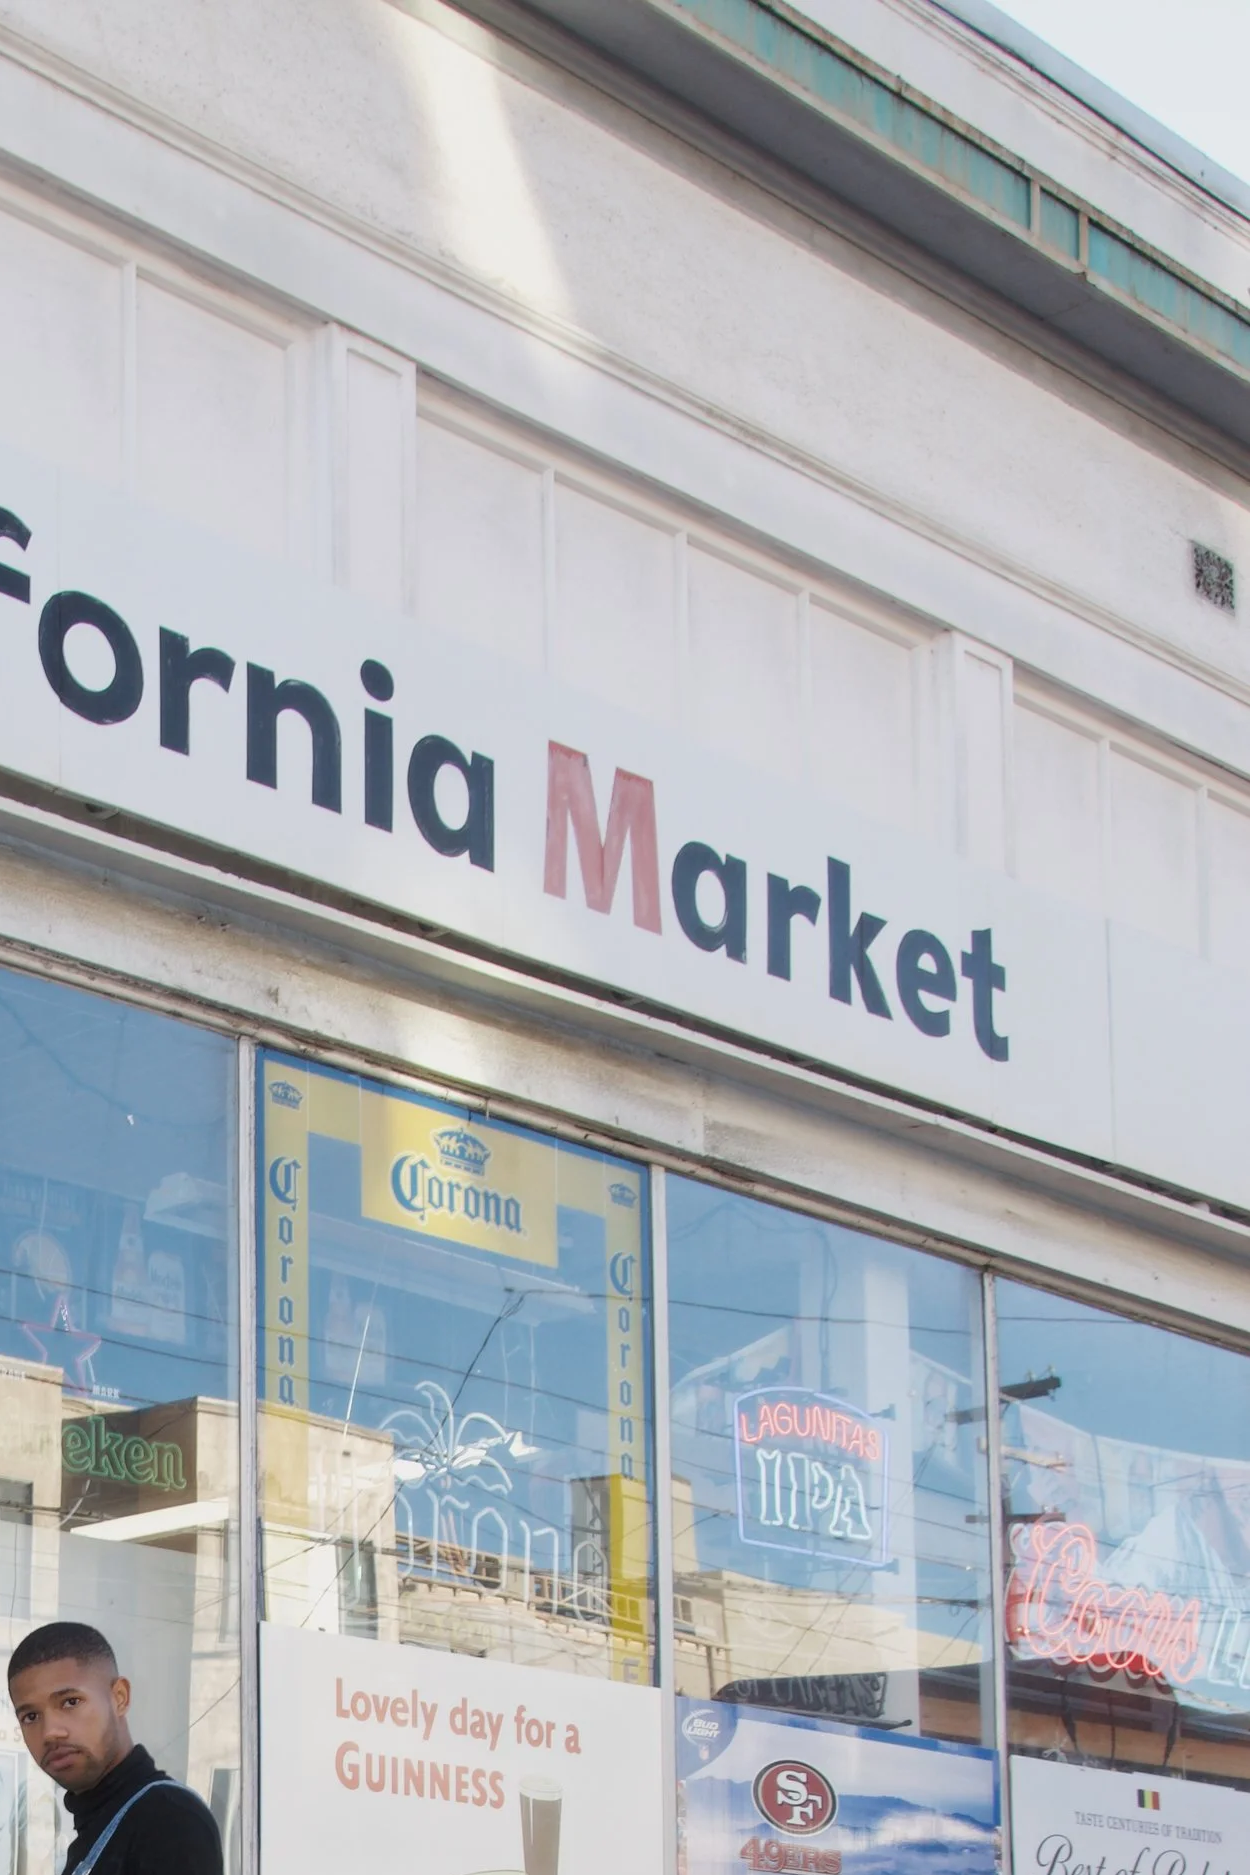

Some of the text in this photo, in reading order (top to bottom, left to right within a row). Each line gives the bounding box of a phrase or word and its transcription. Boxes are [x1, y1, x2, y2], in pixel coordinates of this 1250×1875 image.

[544, 740, 1009, 1062] Market
[391, 1155, 522, 1233] Corona
[268, 1156, 302, 1405] Corona
[93, 1385, 120, 1399] MARK
[610, 1252, 637, 1480] Corona
[741, 1403, 880, 1461] LAGUNITAS
[1025, 1524, 1205, 1684] Coors
[335, 1677, 582, 1754] Lovely day for a
[687, 1727, 720, 1738] LIGHT
[693, 1718, 719, 1729] BUD
[335, 1741, 505, 1811] GUINNESS
[1074, 1811, 1223, 1844] TASTE CENTURIES OF TRADITION
